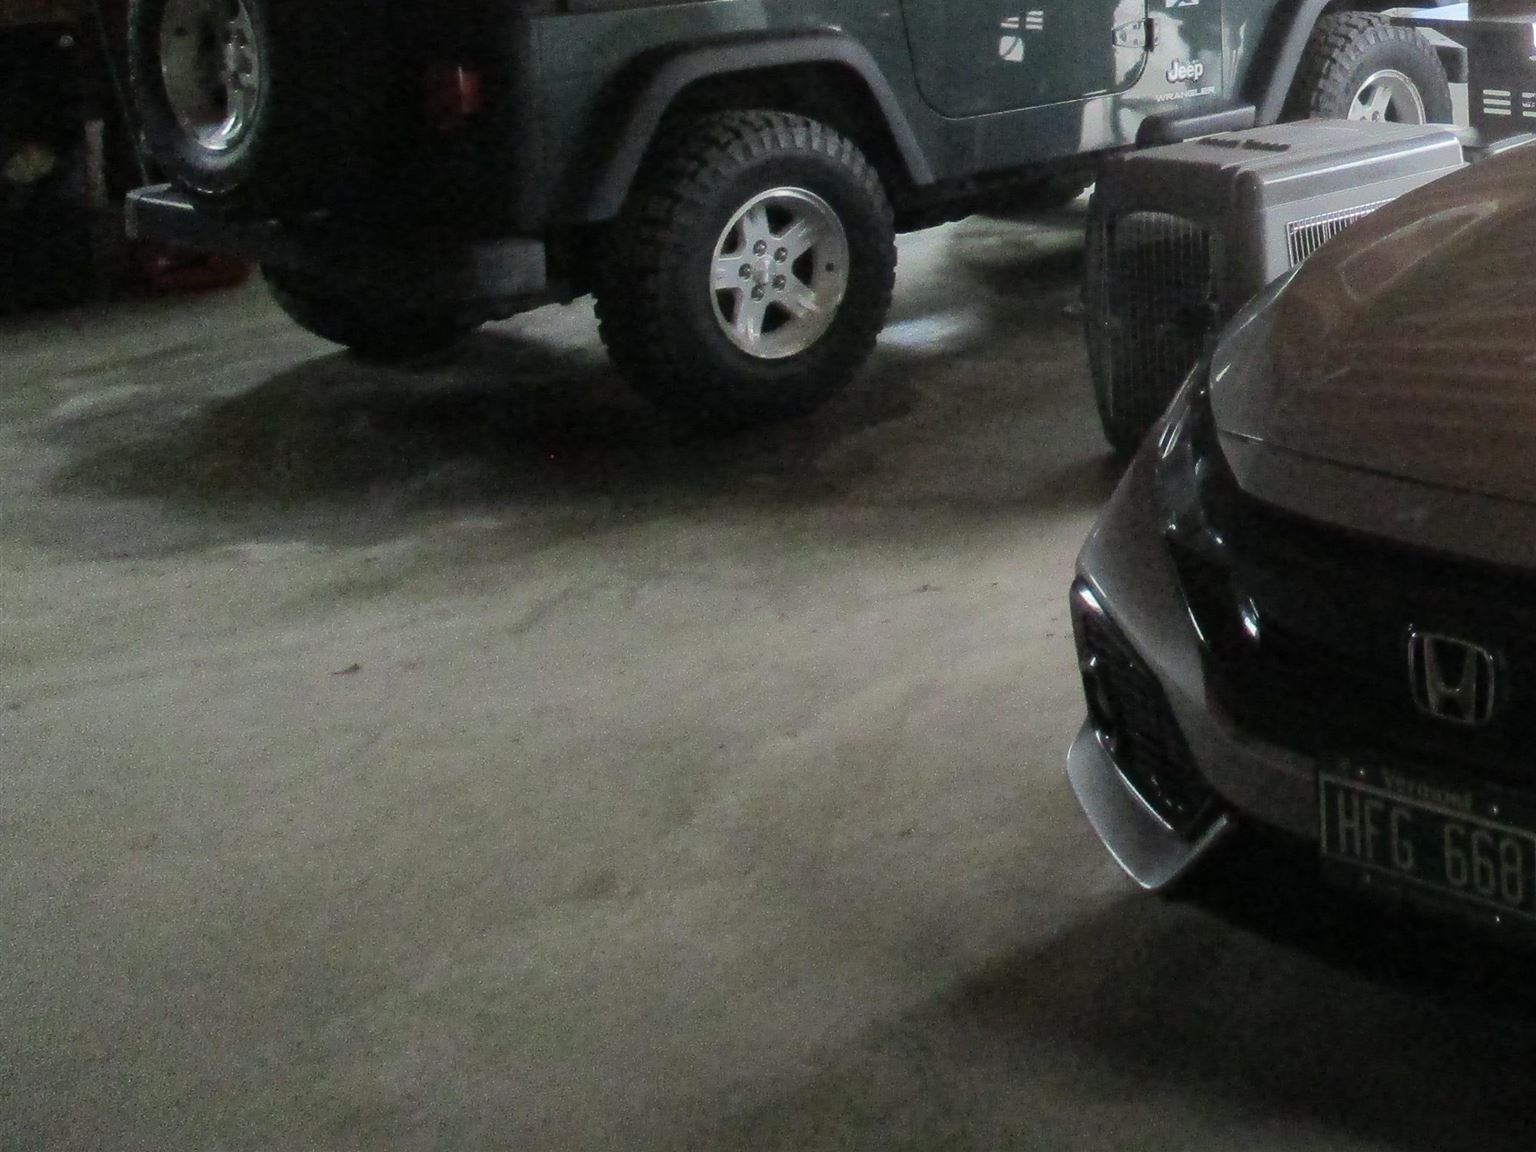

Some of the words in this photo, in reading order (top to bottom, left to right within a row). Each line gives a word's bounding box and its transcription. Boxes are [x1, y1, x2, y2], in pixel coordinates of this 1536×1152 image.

[1167, 57, 1204, 83] Jeep
[1155, 86, 1215, 102] WRANGLER
[1337, 789, 1414, 870] HFG
[1443, 822, 1523, 905] 668
